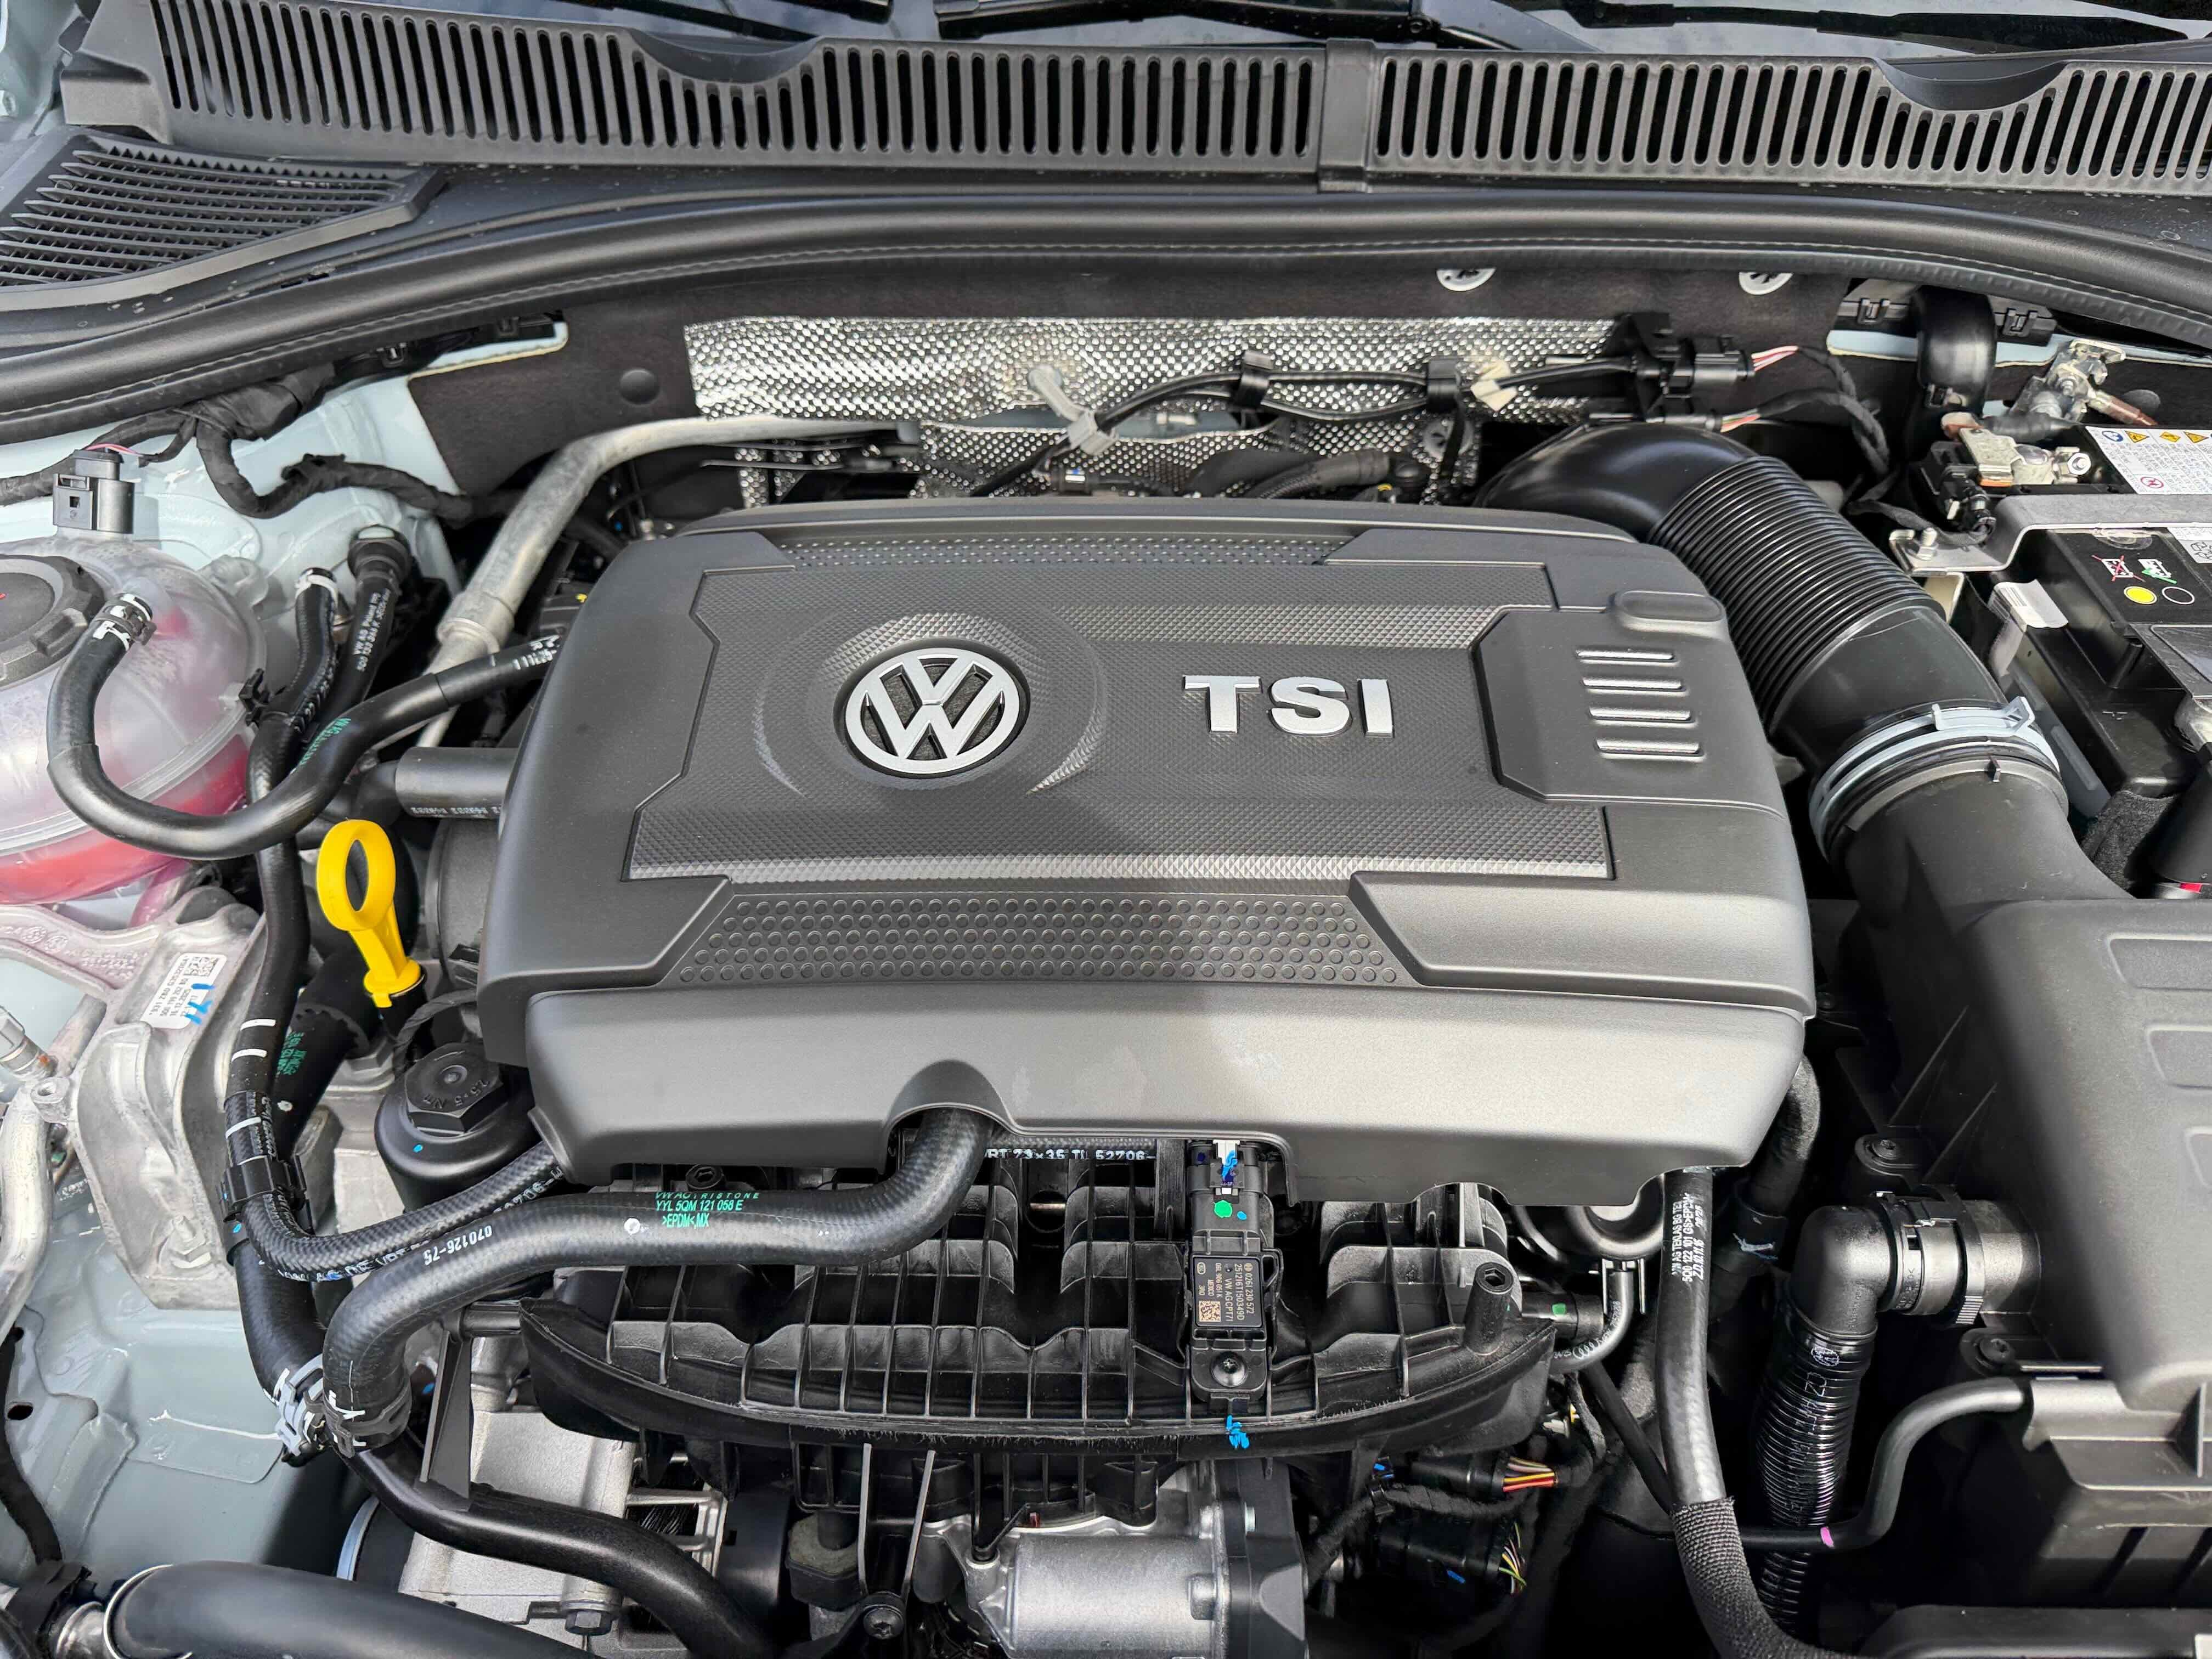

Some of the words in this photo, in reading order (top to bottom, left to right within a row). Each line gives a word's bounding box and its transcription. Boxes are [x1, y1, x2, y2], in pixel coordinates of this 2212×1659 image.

[845, 647, 1022, 775] VW
[1183, 675, 1395, 737] TSI
[656, 1199, 674, 1212] YYL
[675, 1199, 698, 1212] 5QM
[699, 1199, 715, 1212] 121
[716, 1199, 735, 1211] 058
[735, 1199, 744, 1211] E
[1672, 1213, 1683, 1225] BG
[423, 1223, 493, 1266] 070126-75
[1672, 1224, 1683, 1251] TEKLAS
[1683, 1235, 1694, 1249] 101
[1682, 1249, 1694, 1264] 122
